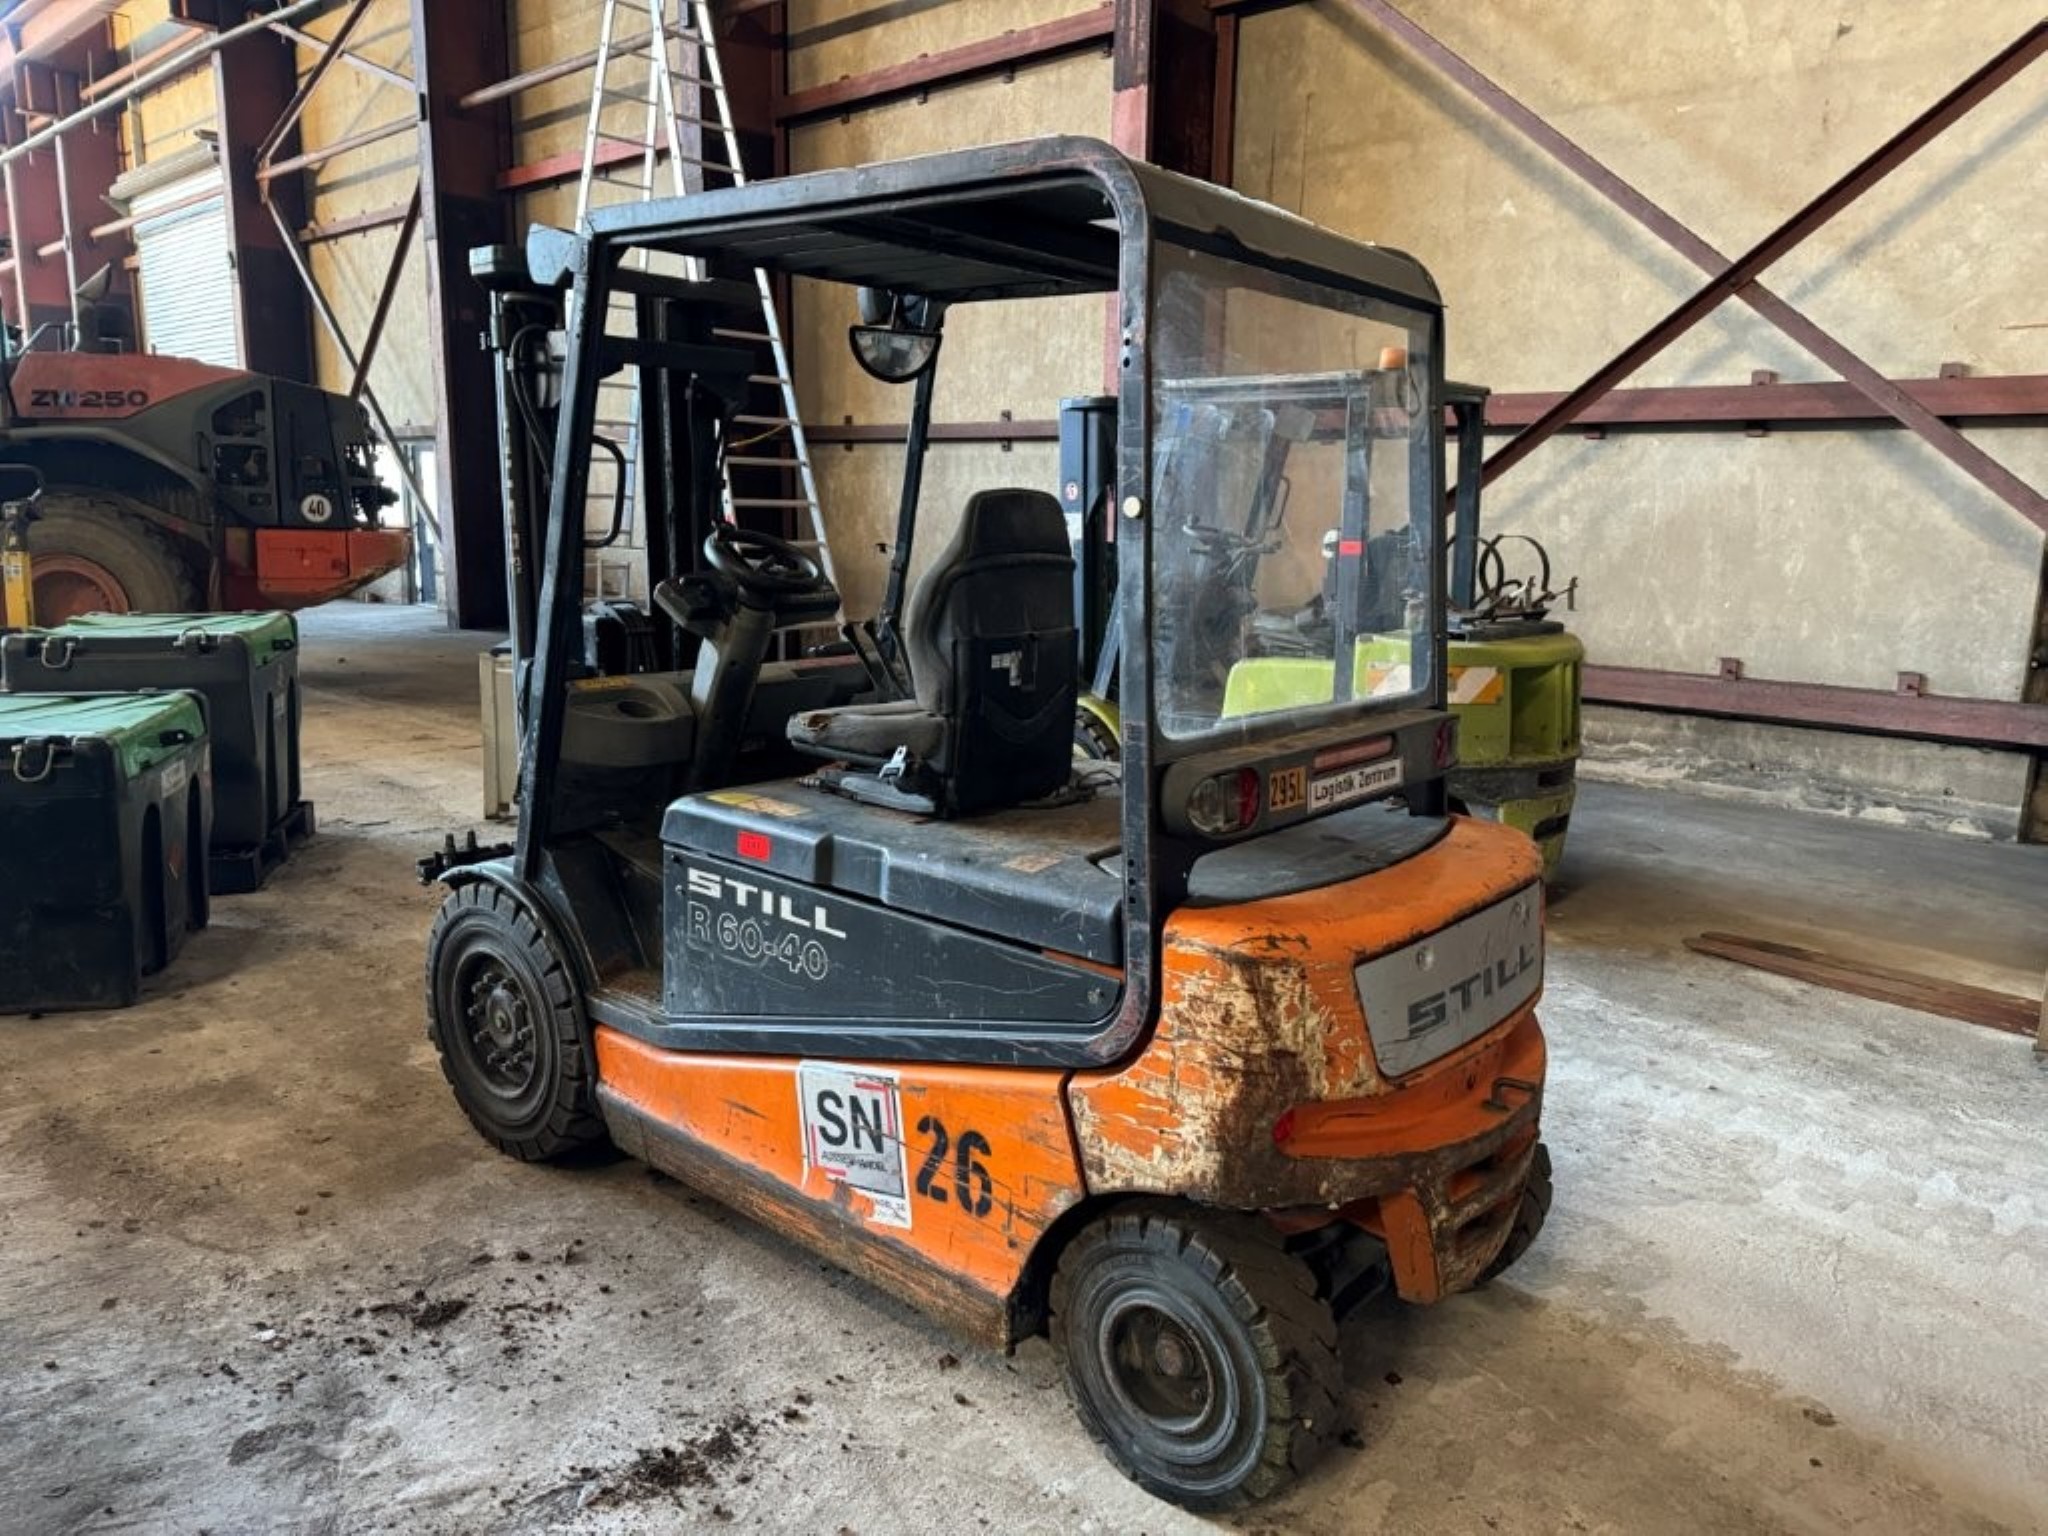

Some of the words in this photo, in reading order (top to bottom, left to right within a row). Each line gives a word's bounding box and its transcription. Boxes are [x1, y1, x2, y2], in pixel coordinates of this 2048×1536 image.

[308, 499, 324, 517] 40
[1315, 774, 1355, 802] Logistik
[688, 867, 846, 939] STILL
[688, 900, 712, 942] R
[717, 911, 828, 980] 60-40
[1408, 945, 1534, 1038] STILL
[816, 1089, 884, 1154] SN
[916, 1114, 992, 1218] 26
